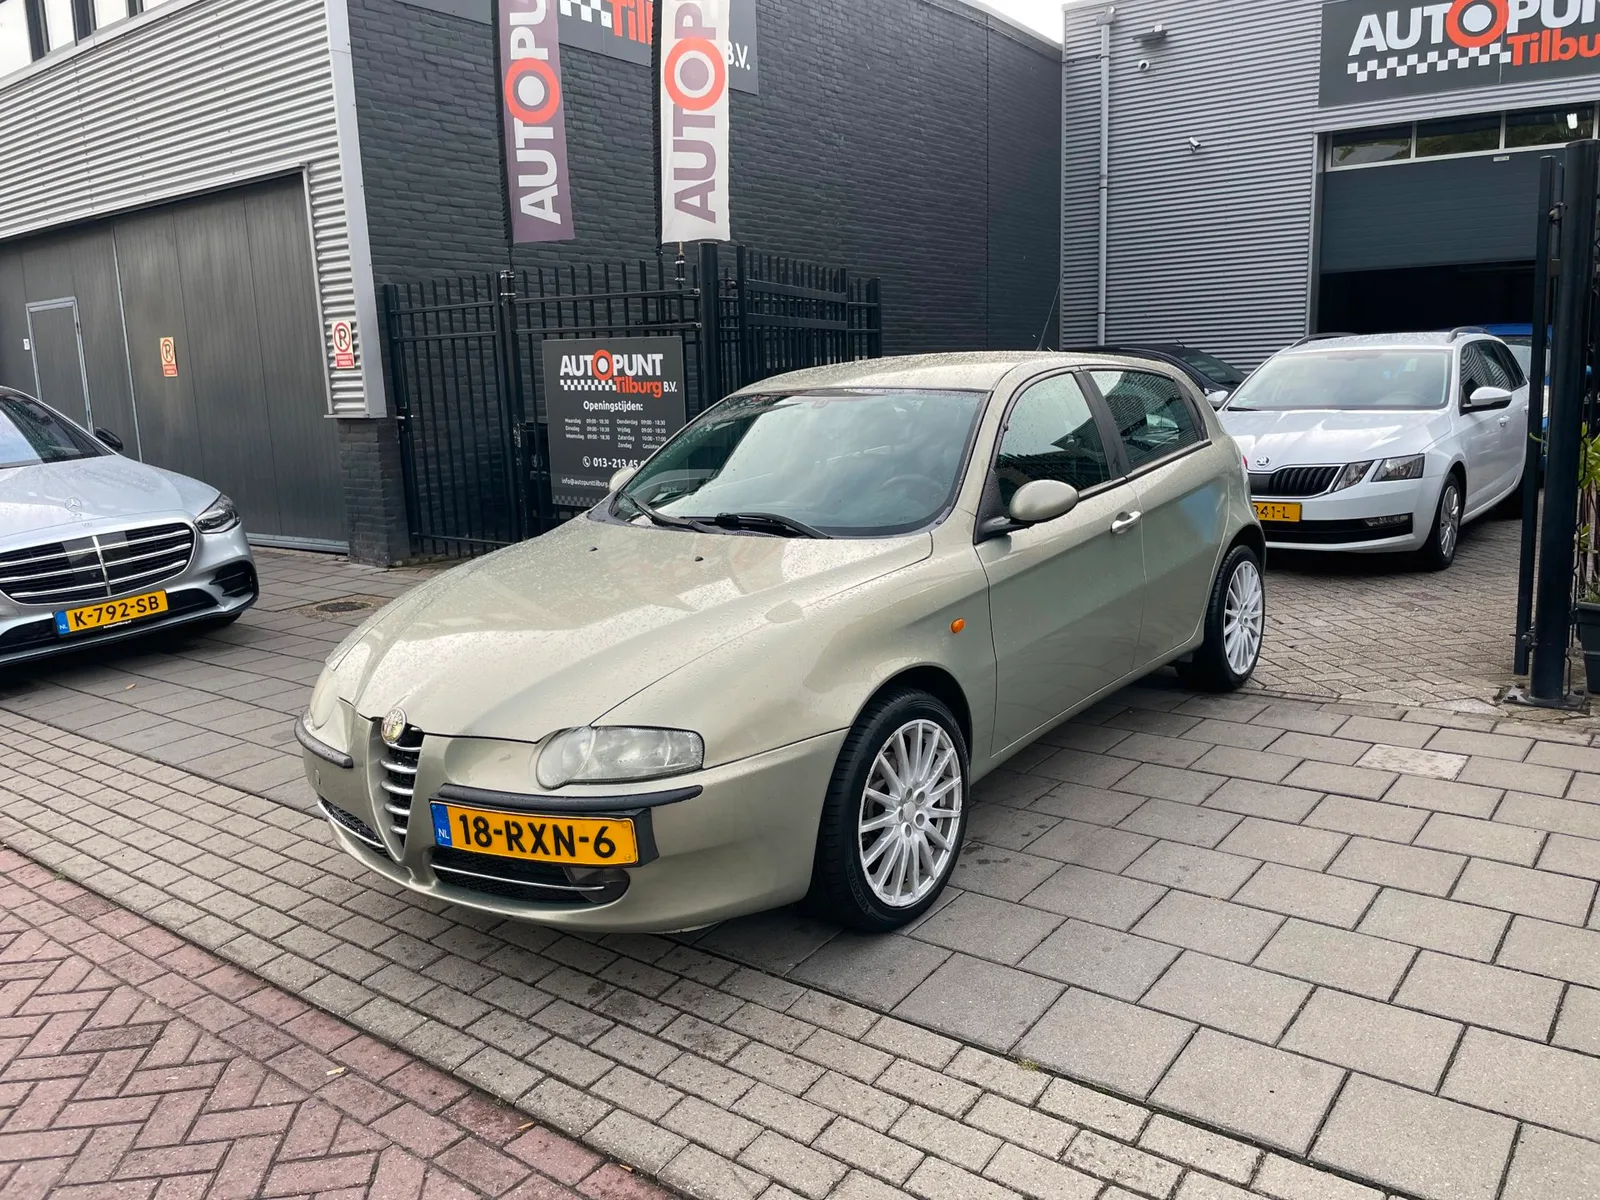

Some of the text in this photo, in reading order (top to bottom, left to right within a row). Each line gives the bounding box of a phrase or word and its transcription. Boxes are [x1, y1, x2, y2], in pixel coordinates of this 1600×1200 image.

[664, 0, 726, 224] AUTOP
[560, 350, 663, 380] AUTOPUNT
[614, 376, 677, 398] Tilburg B.V.
[583, 400, 643, 412] Openingstijden:
[73, 595, 159, 627] K-792-SB
[438, 814, 616, 858] NL 18-RXN-6
